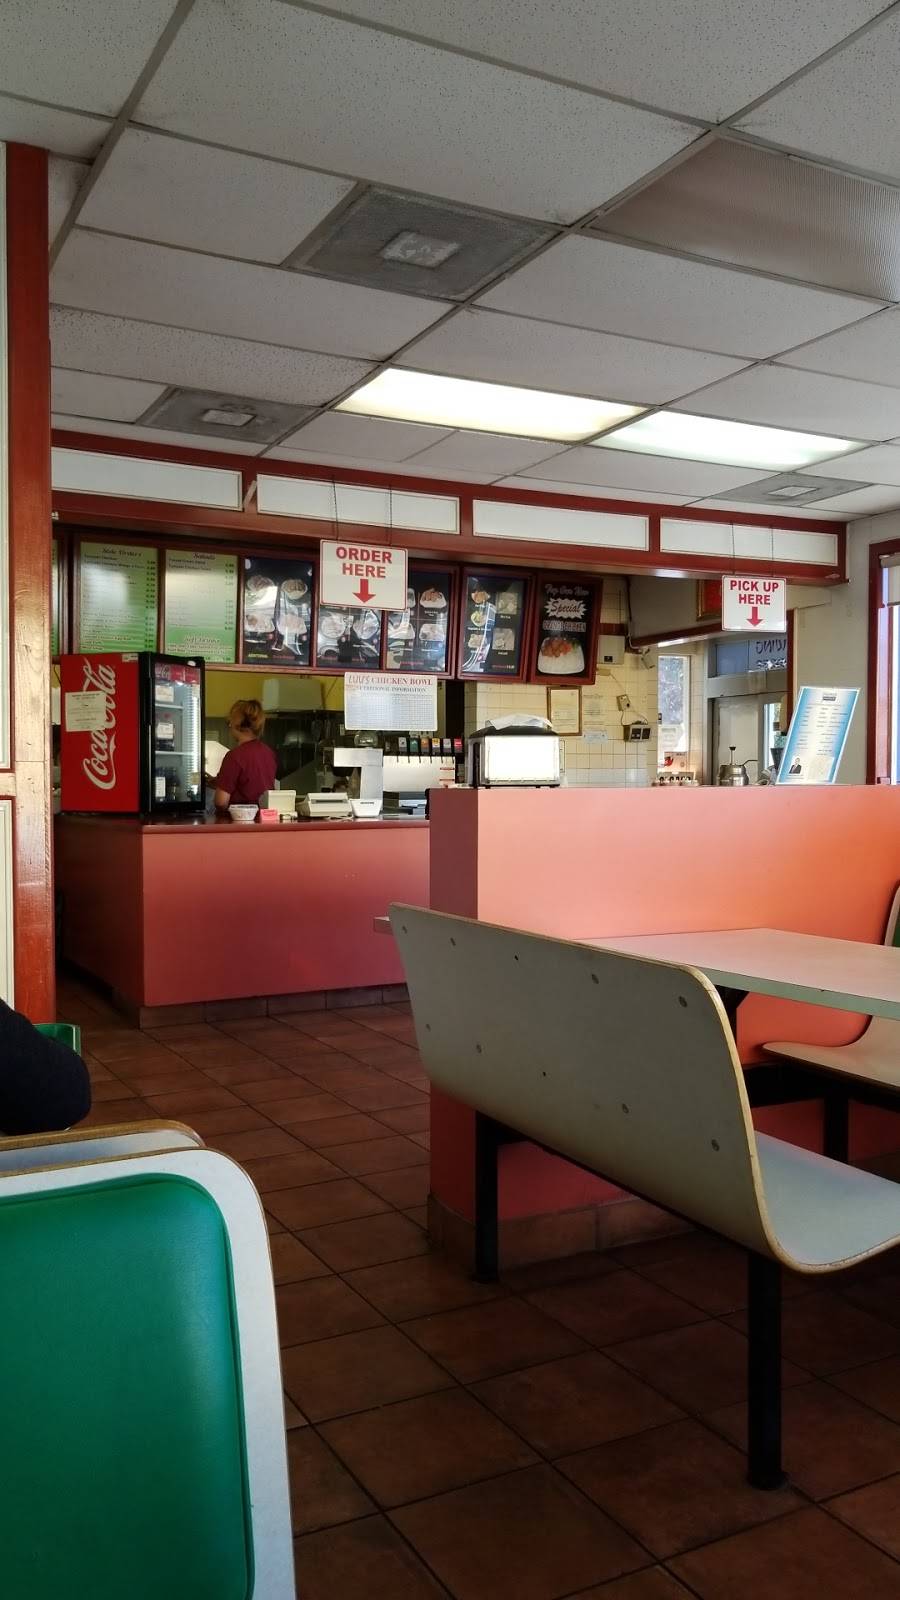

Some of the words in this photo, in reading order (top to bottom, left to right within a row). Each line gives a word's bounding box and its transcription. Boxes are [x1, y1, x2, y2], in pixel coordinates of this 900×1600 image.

[336, 546, 392, 563] ORDER
[342, 563, 386, 578] HERE
[730, 580, 759, 591] PICK
[763, 581, 779, 592] UP
[739, 593, 771, 605] HERE
[550, 600, 581, 614] Special
[371, 677, 408, 685] CHICKEN
[410, 678, 432, 686] BOWL
[83, 656, 116, 790] CocaCola
